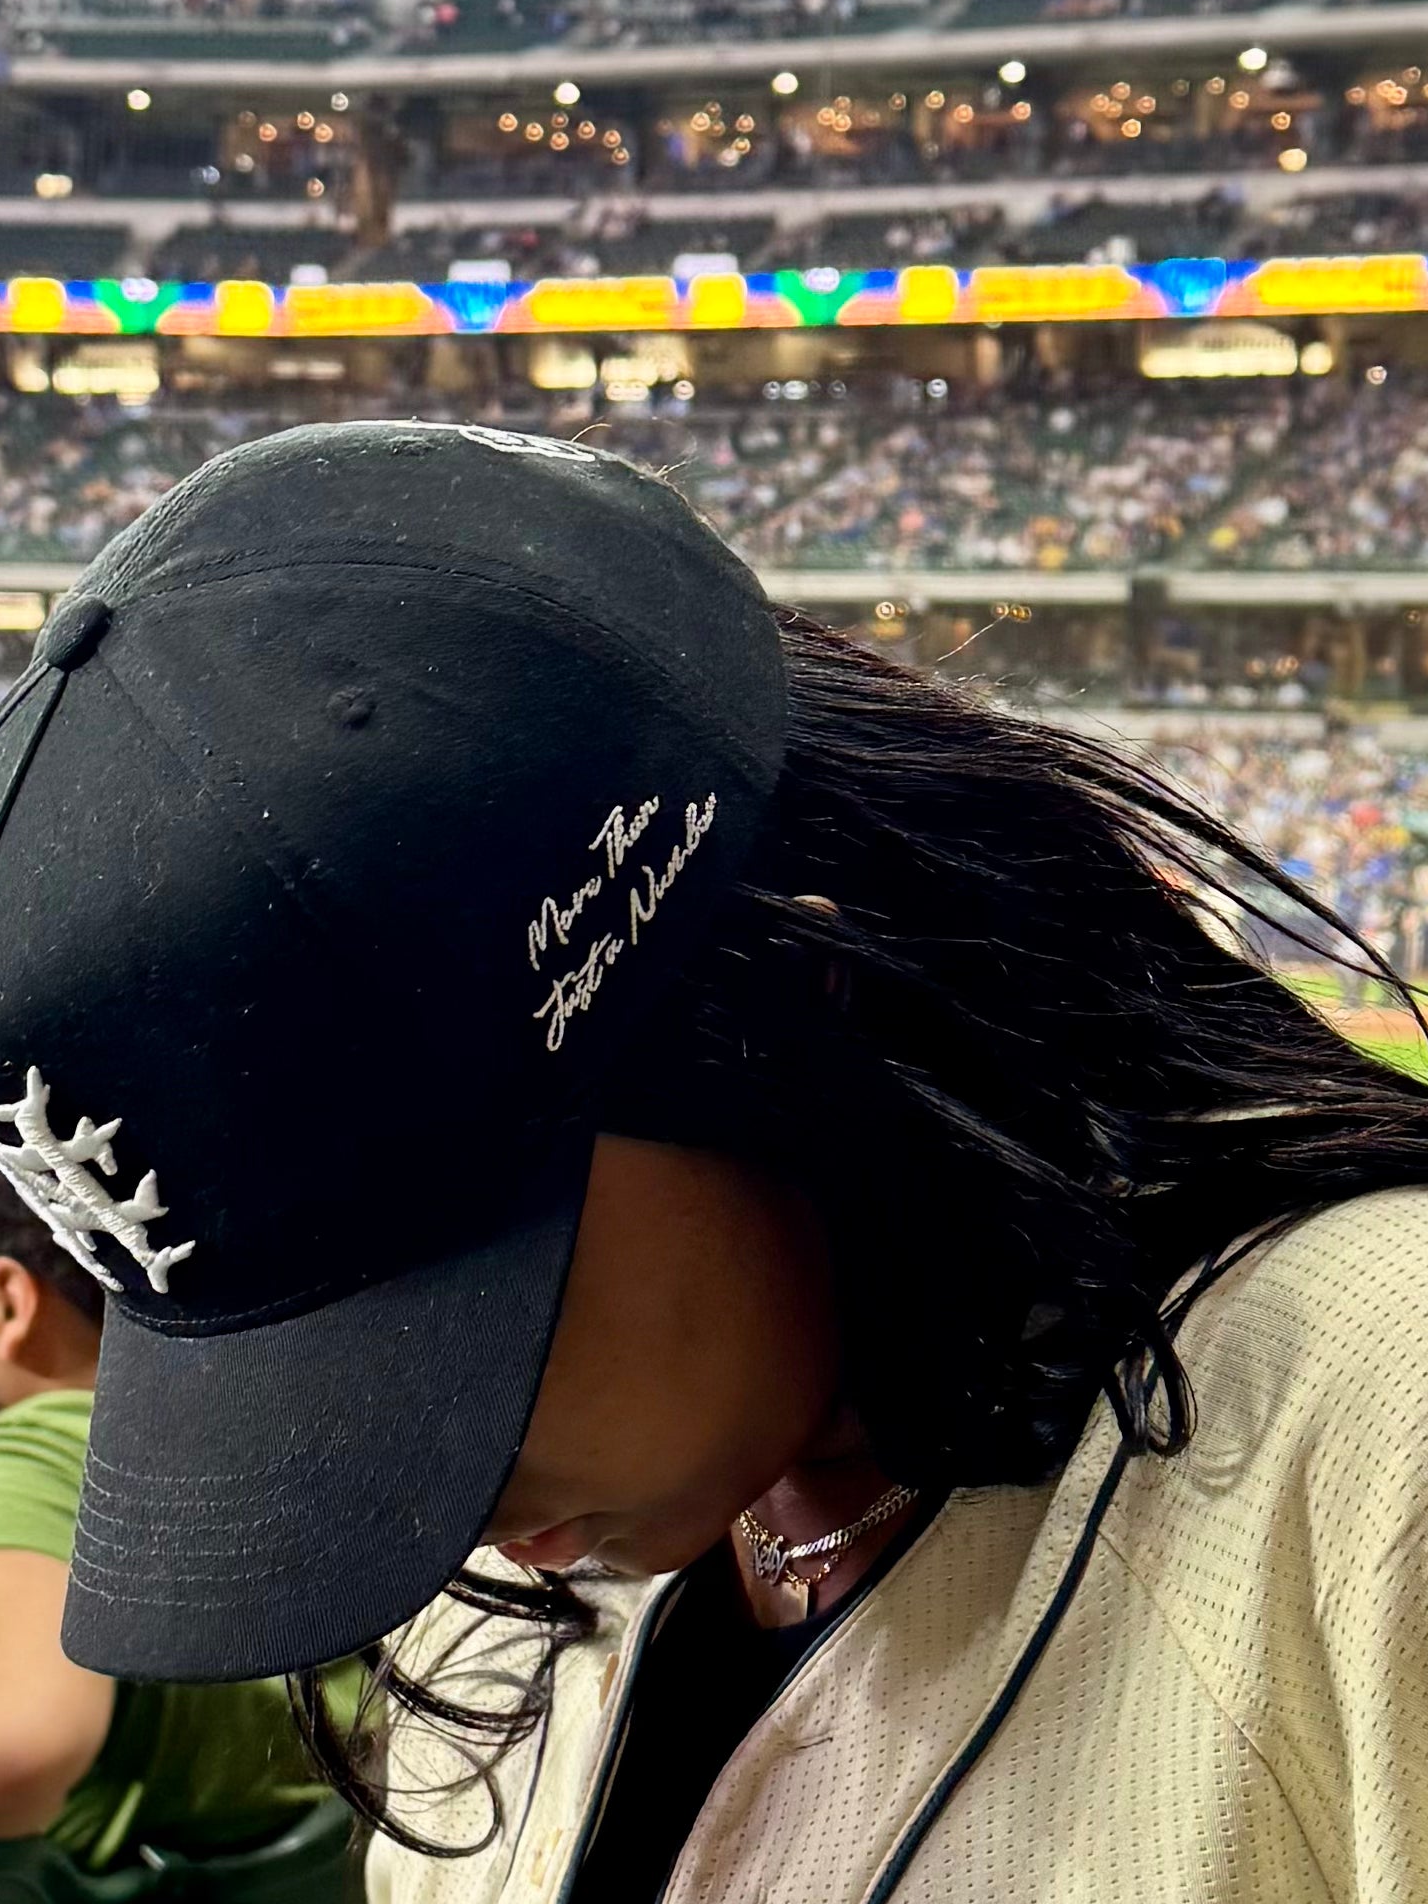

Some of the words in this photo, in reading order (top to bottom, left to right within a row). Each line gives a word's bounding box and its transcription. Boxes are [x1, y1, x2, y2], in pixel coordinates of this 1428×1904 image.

[529, 876, 601, 971] More
[589, 796, 659, 879] Than
[533, 933, 612, 1051] Just
[604, 939, 624, 965] a
[629, 792, 717, 945] Number
